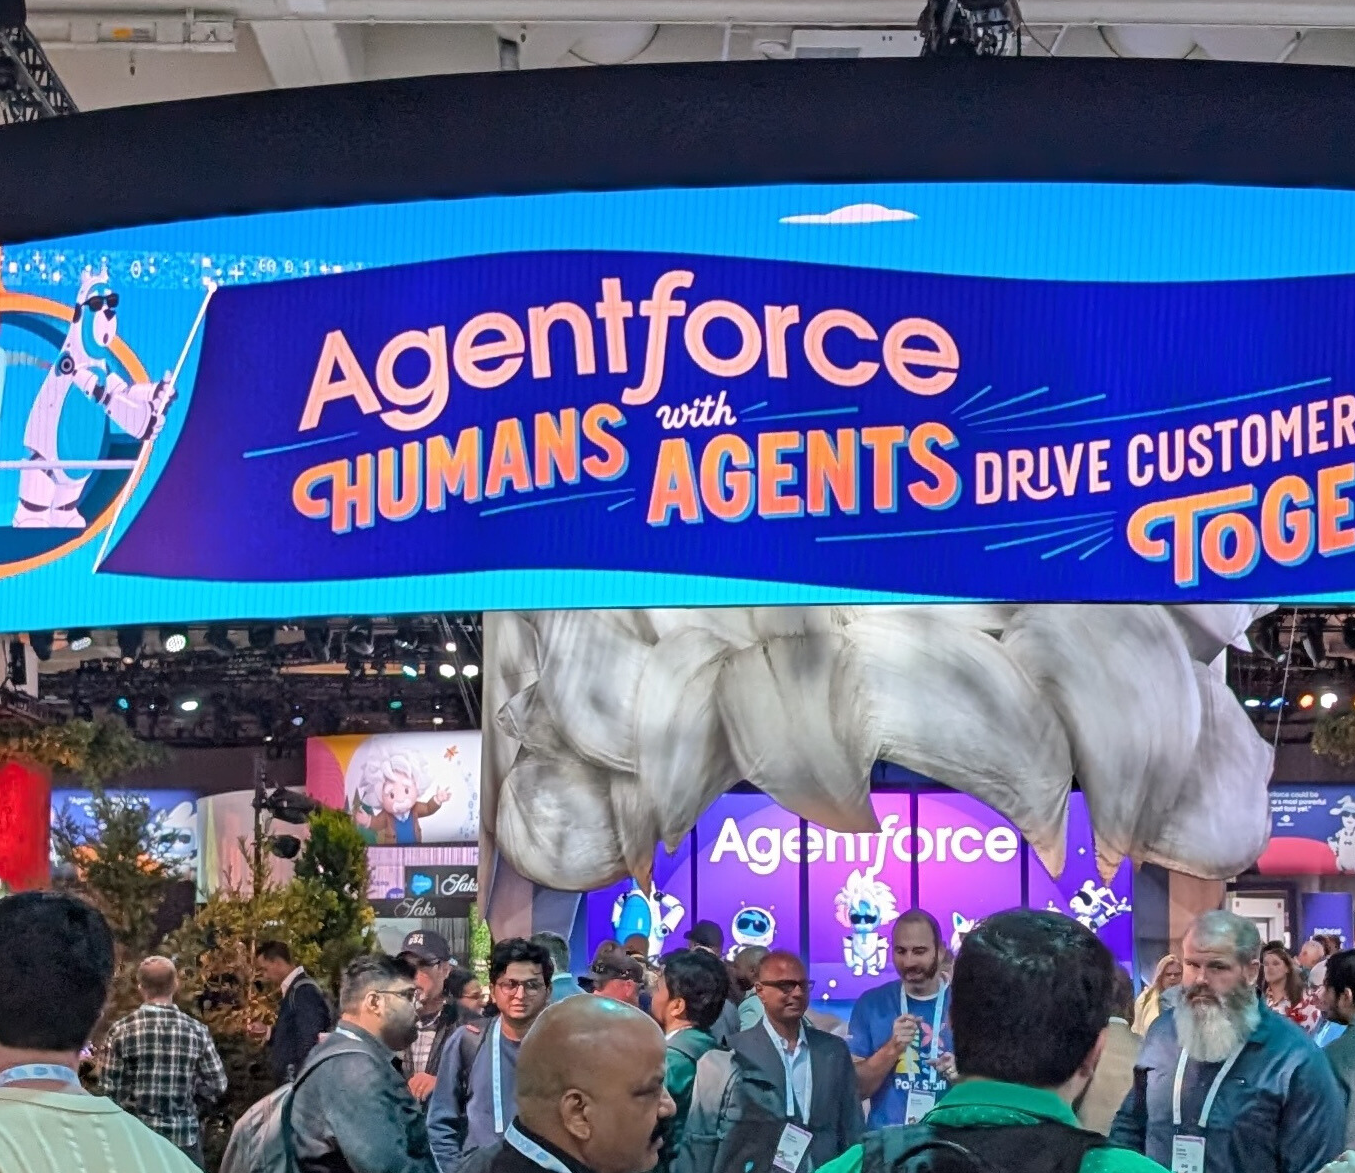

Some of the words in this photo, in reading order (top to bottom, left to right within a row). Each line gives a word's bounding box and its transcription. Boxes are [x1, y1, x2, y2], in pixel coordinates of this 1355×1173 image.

[298, 270, 959, 431] Agentforce
[656, 391, 738, 430] with
[292, 404, 628, 534] HUMANS
[646, 422, 962, 527] AGENTS
[975, 439, 1111, 504] DRIVE
[710, 814, 1018, 877] Agentforce
[394, 897, 436, 918] Saks
